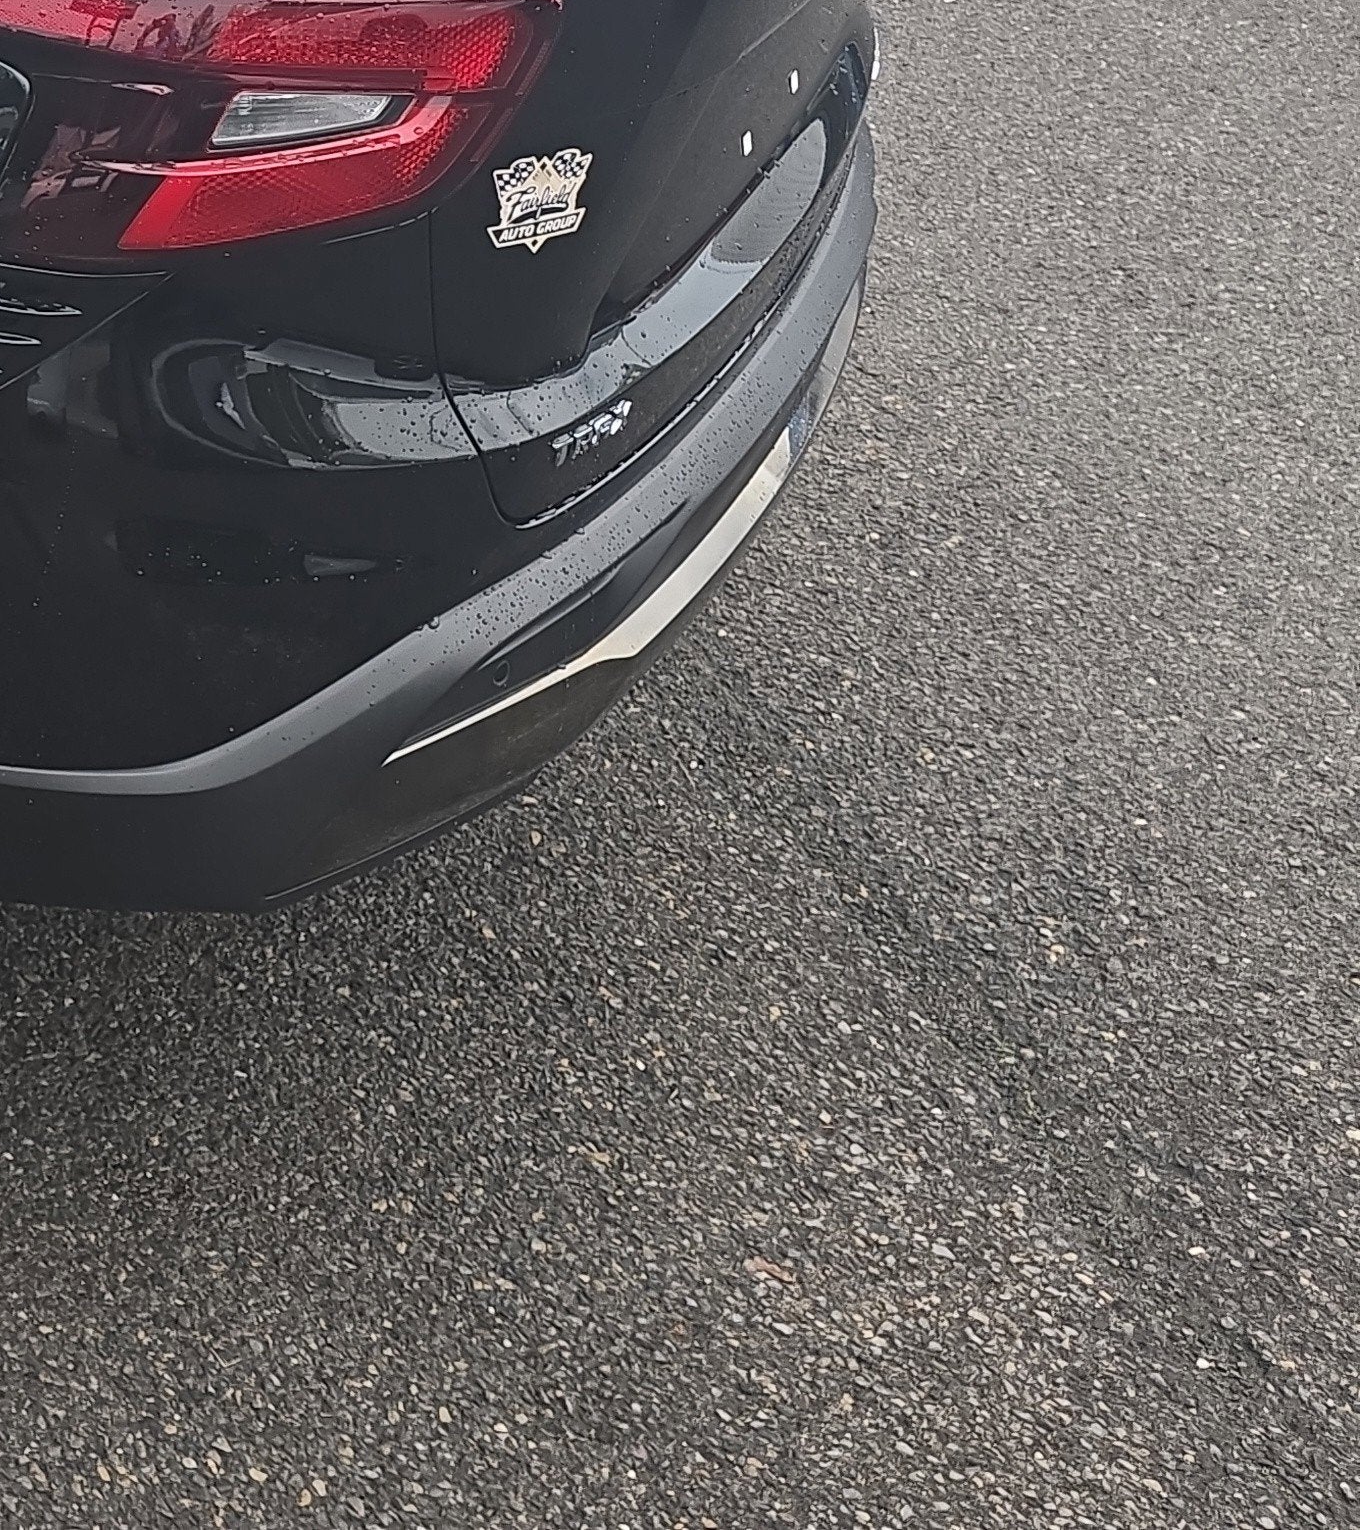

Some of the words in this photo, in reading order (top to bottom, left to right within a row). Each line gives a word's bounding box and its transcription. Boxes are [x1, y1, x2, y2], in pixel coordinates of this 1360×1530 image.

[505, 183, 577, 223] Fairfield
[499, 224, 535, 242] AUTO
[536, 215, 578, 235] GROUP
